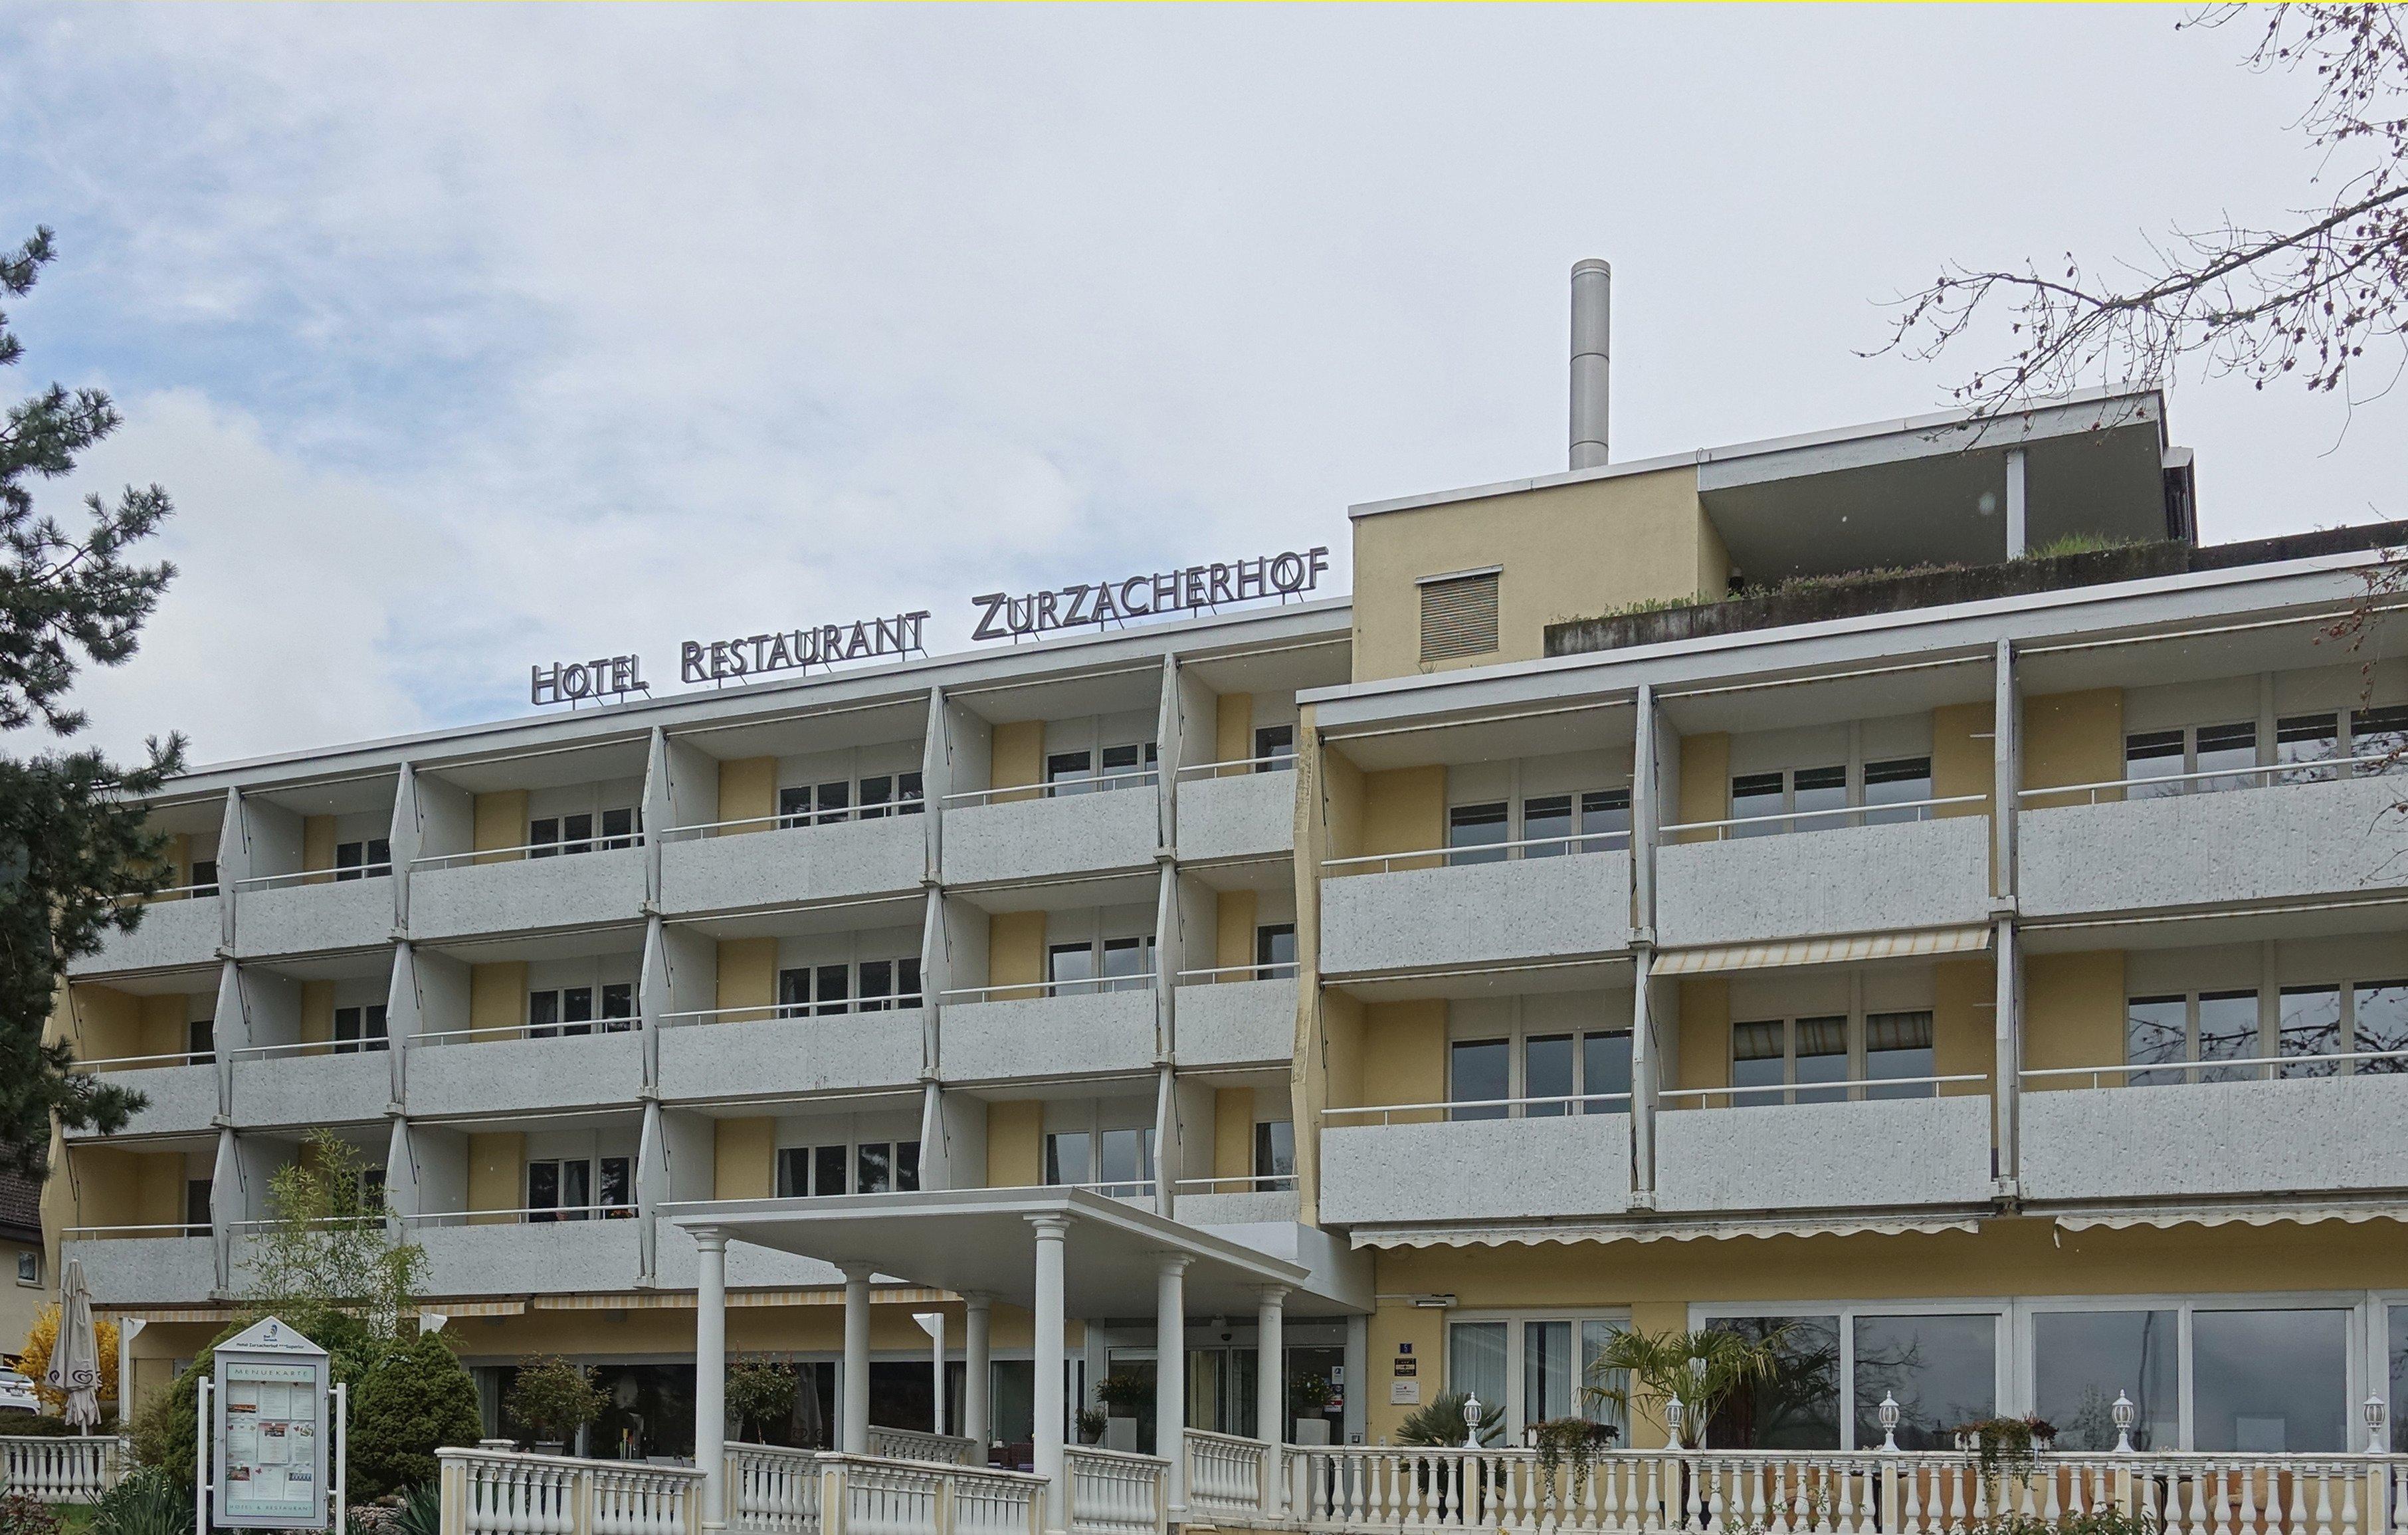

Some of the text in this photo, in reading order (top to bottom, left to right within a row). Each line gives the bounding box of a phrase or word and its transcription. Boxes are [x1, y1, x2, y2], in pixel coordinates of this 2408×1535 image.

[532, 546, 1329, 705] HOTEL RESTAURANT ZURZACHERHOF
